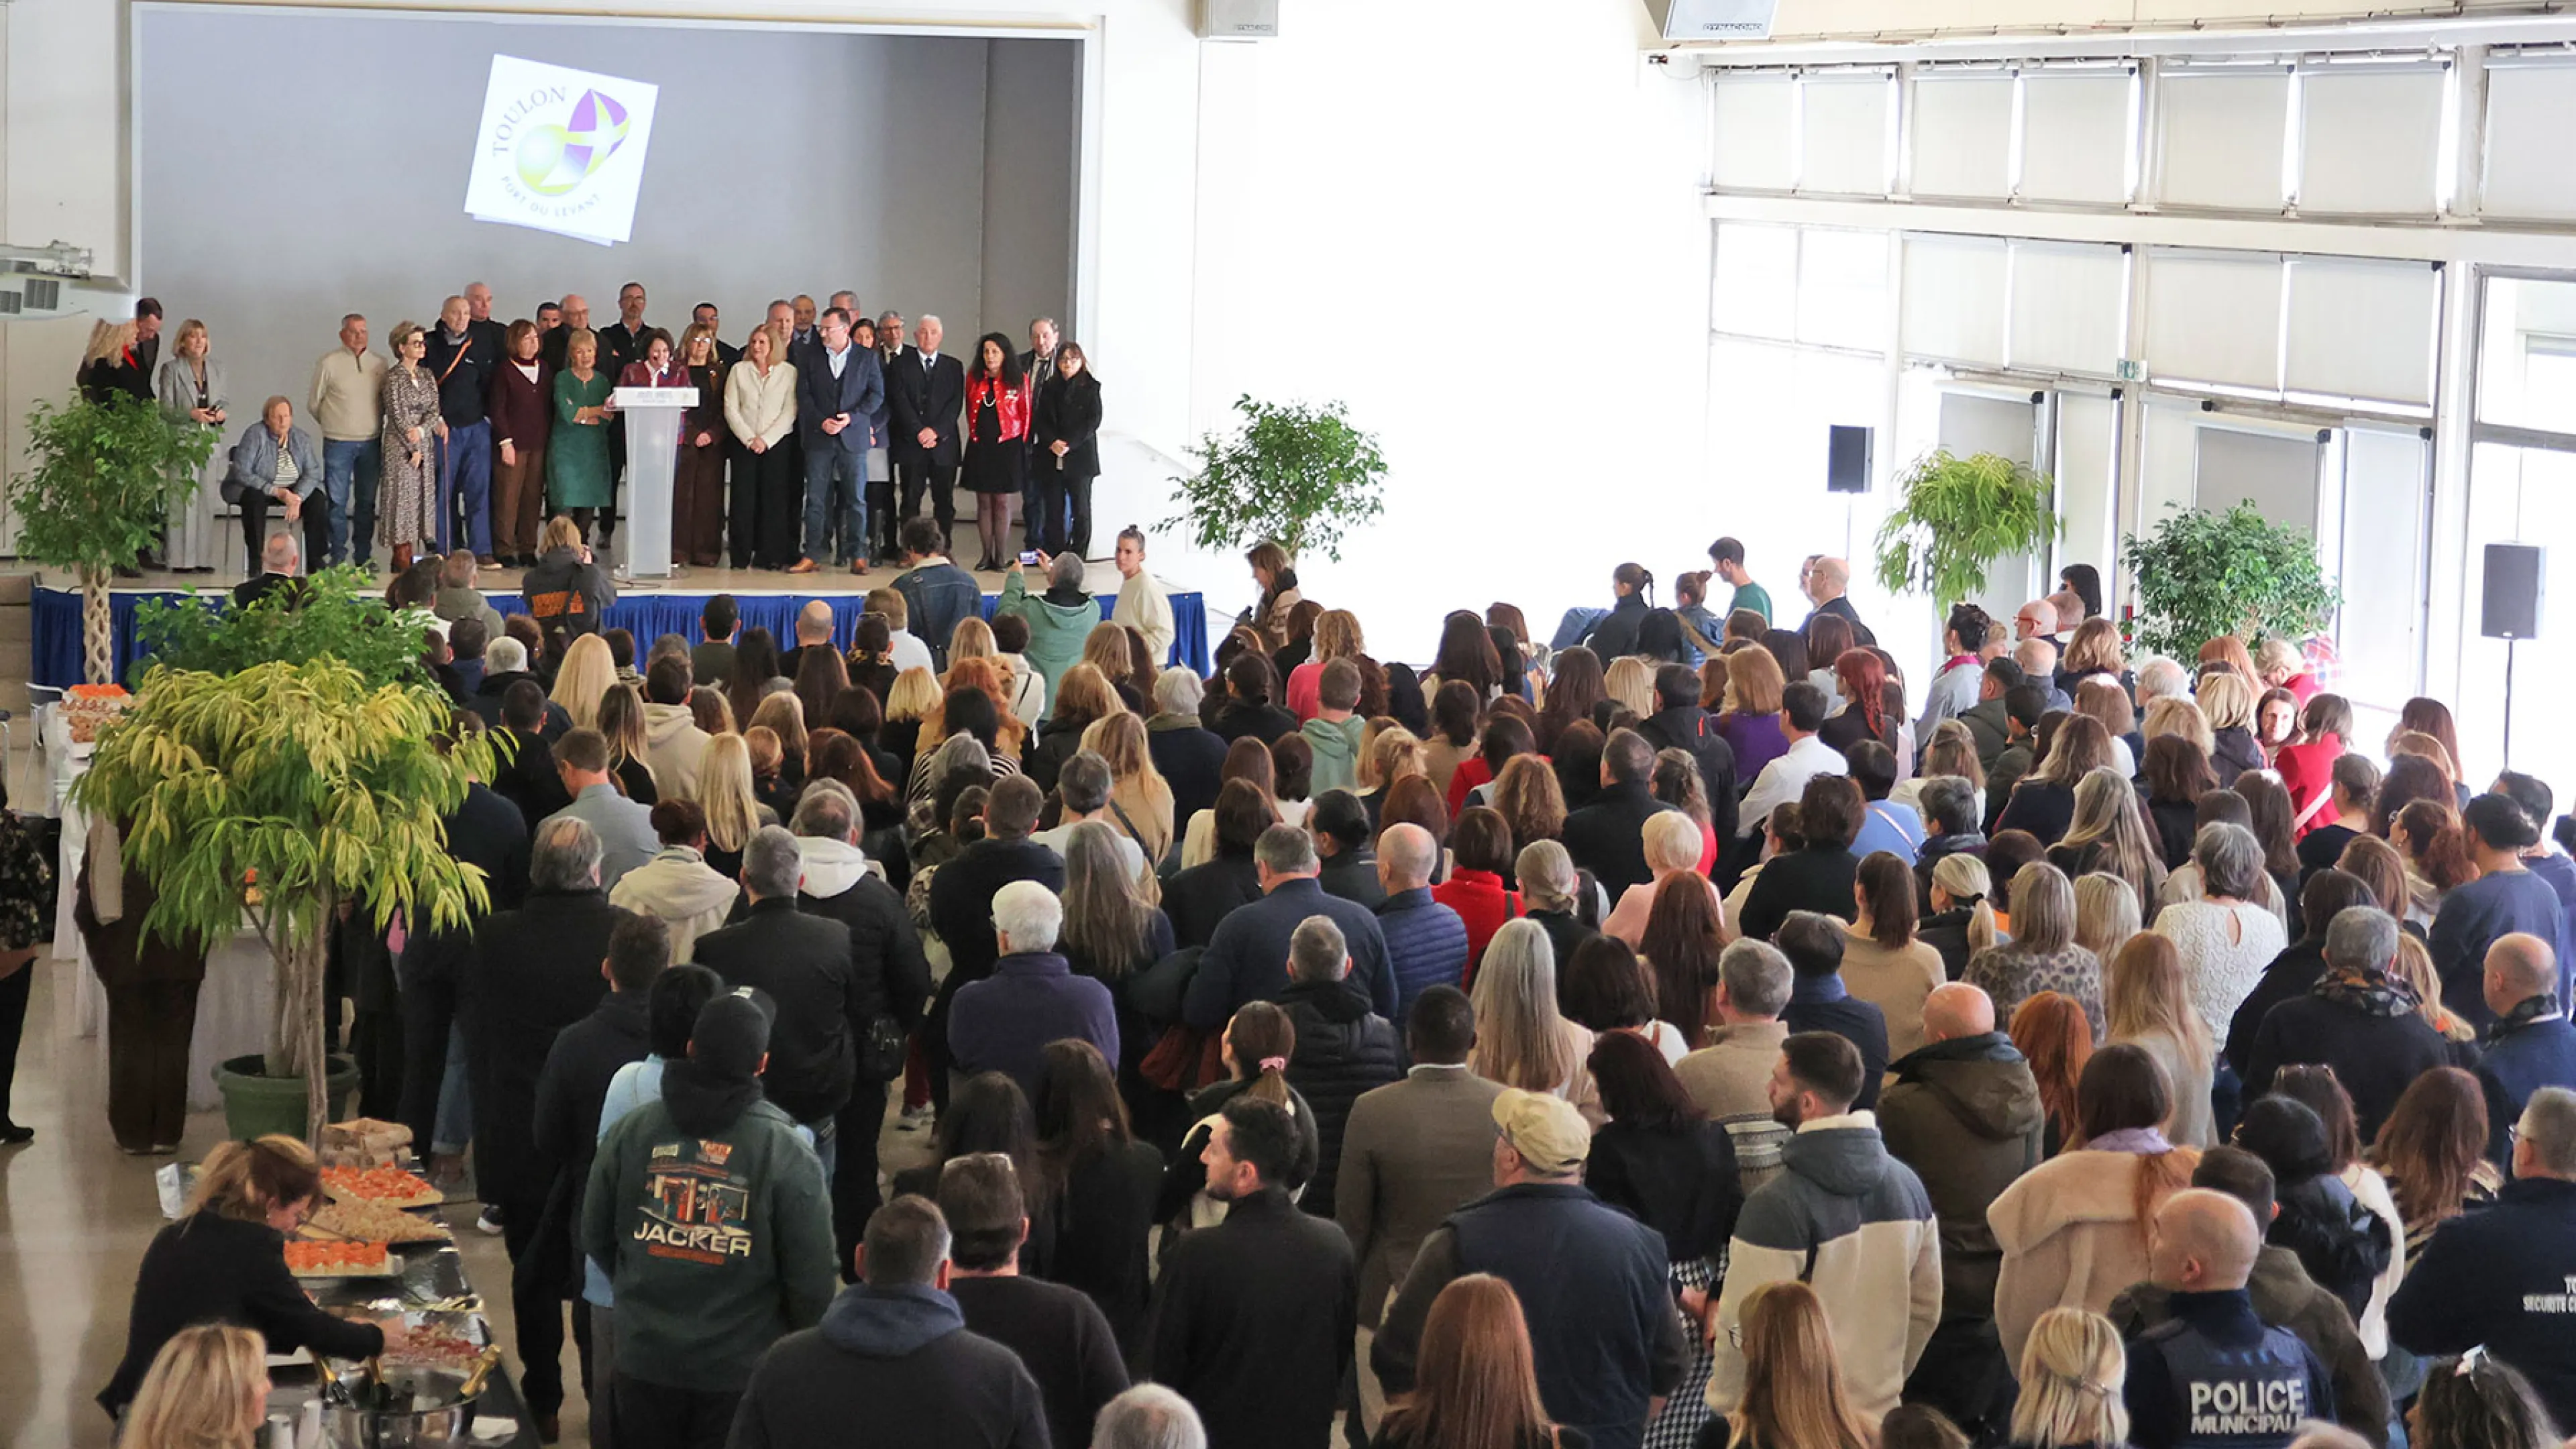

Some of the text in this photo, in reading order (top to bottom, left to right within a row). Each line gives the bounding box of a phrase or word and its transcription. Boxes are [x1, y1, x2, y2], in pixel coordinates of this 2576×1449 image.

[492, 86, 567, 157] TOULON
[500, 176, 600, 217] PORT DU LEVANT
[633, 1221, 752, 1258] JACKER
[2190, 1379, 2305, 1415] POLICE
